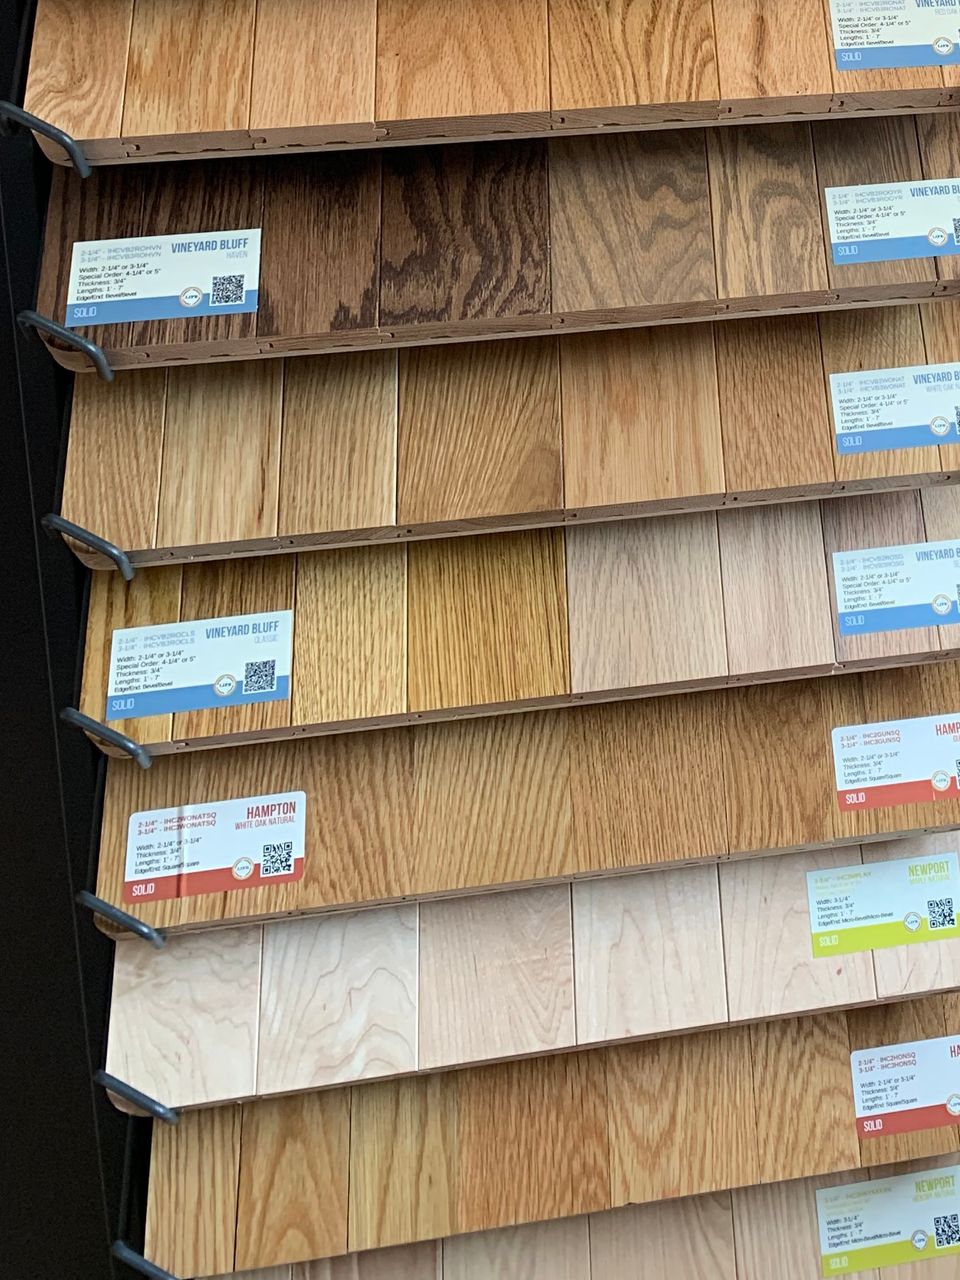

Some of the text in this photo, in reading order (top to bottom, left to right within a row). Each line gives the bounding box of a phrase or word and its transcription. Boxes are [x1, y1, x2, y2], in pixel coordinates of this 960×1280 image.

[840, 51, 861, 61] SOLID
[910, 185, 950, 197] VINEYARD
[170, 240, 217, 253] VINEYARD
[219, 237, 248, 250] BLUFF
[837, 245, 858, 255] SOLID
[73, 306, 96, 318] SOLID
[912, 371, 952, 384] VINEYARD
[842, 435, 862, 447] SOLID
[915, 548, 954, 561] VINEYARD
[205, 620, 279, 639] VINEYARD BLUFF
[111, 698, 134, 711] SOLID
[845, 792, 865, 804] SOLID
[246, 801, 296, 819] HAMPTON
[234, 820, 252, 830] WHITE
[268, 814, 294, 825] NATURAL
[908, 860, 950, 877] NEWPORT
[132, 882, 154, 896] SOLID
[863, 1118, 882, 1131] SOLID
[914, 1175, 955, 1193] NEWPORT
